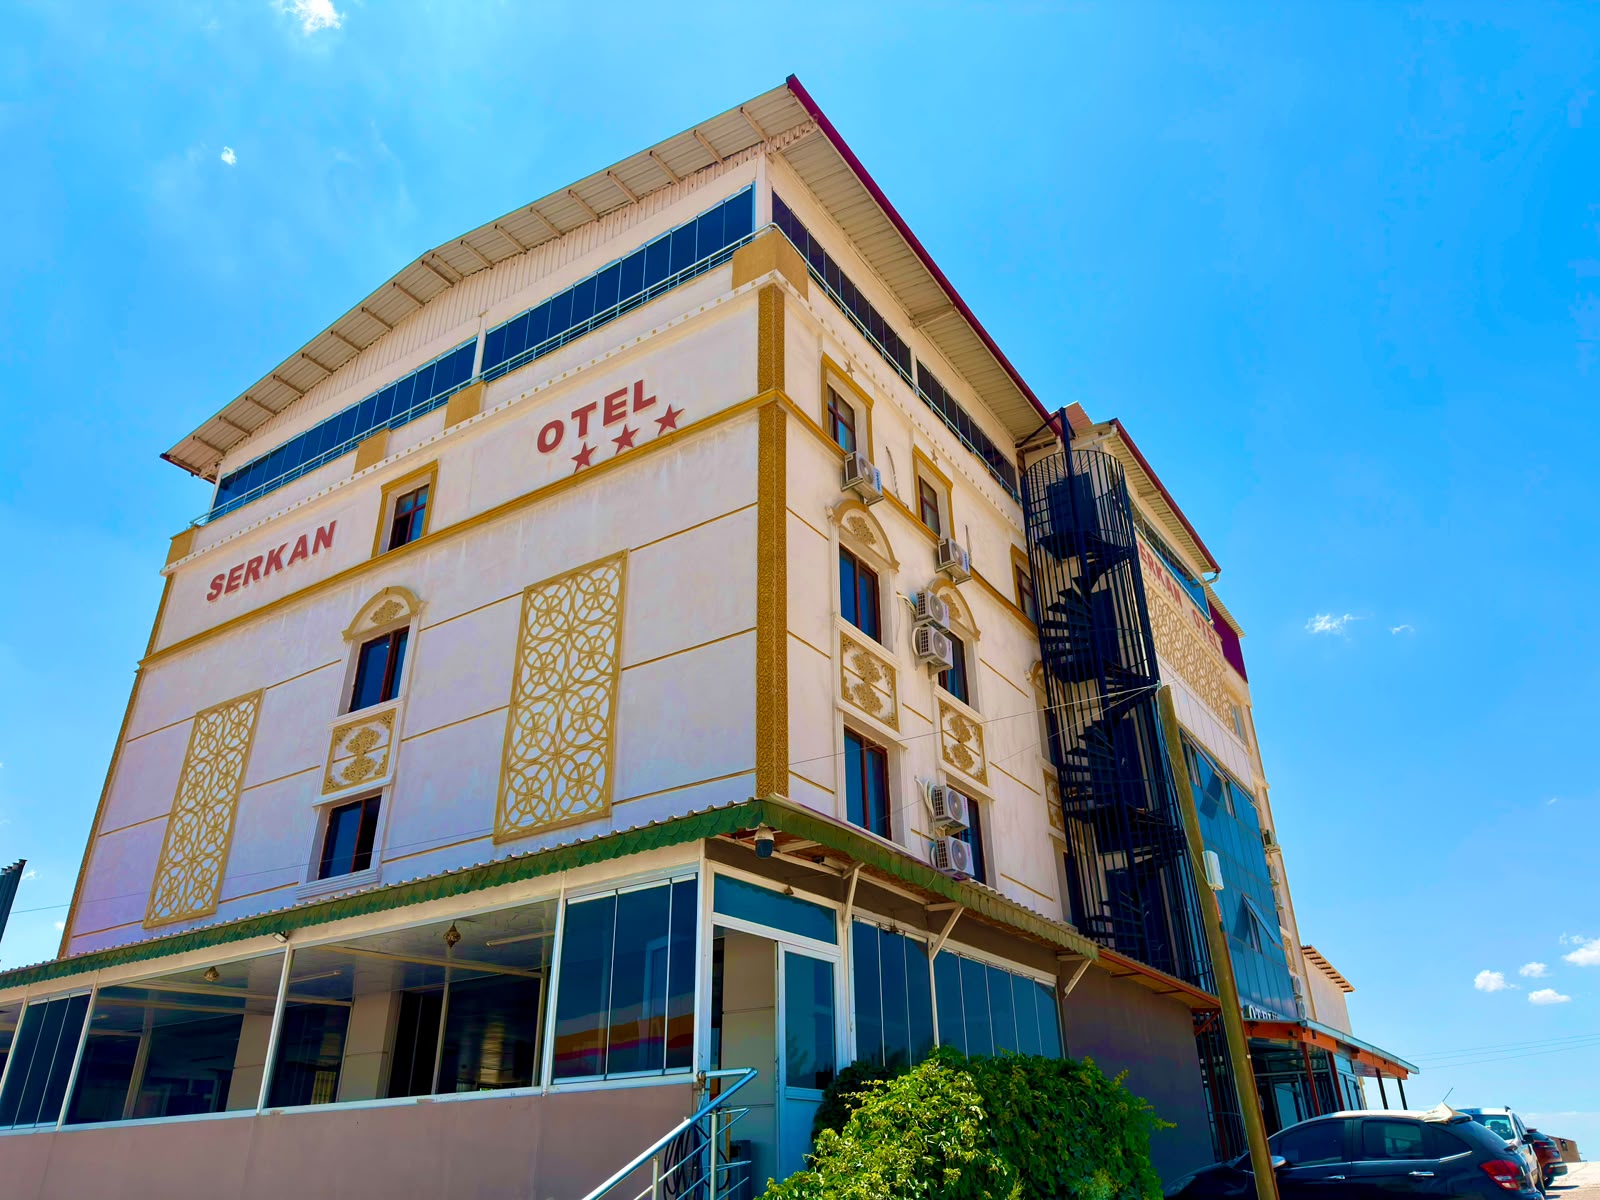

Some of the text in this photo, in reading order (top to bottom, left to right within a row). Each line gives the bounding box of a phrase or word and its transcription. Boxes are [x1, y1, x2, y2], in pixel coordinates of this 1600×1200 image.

[206, 379, 657, 601] SERKAN OTEL
[1136, 541, 1221, 654] ERKAN OTEL
